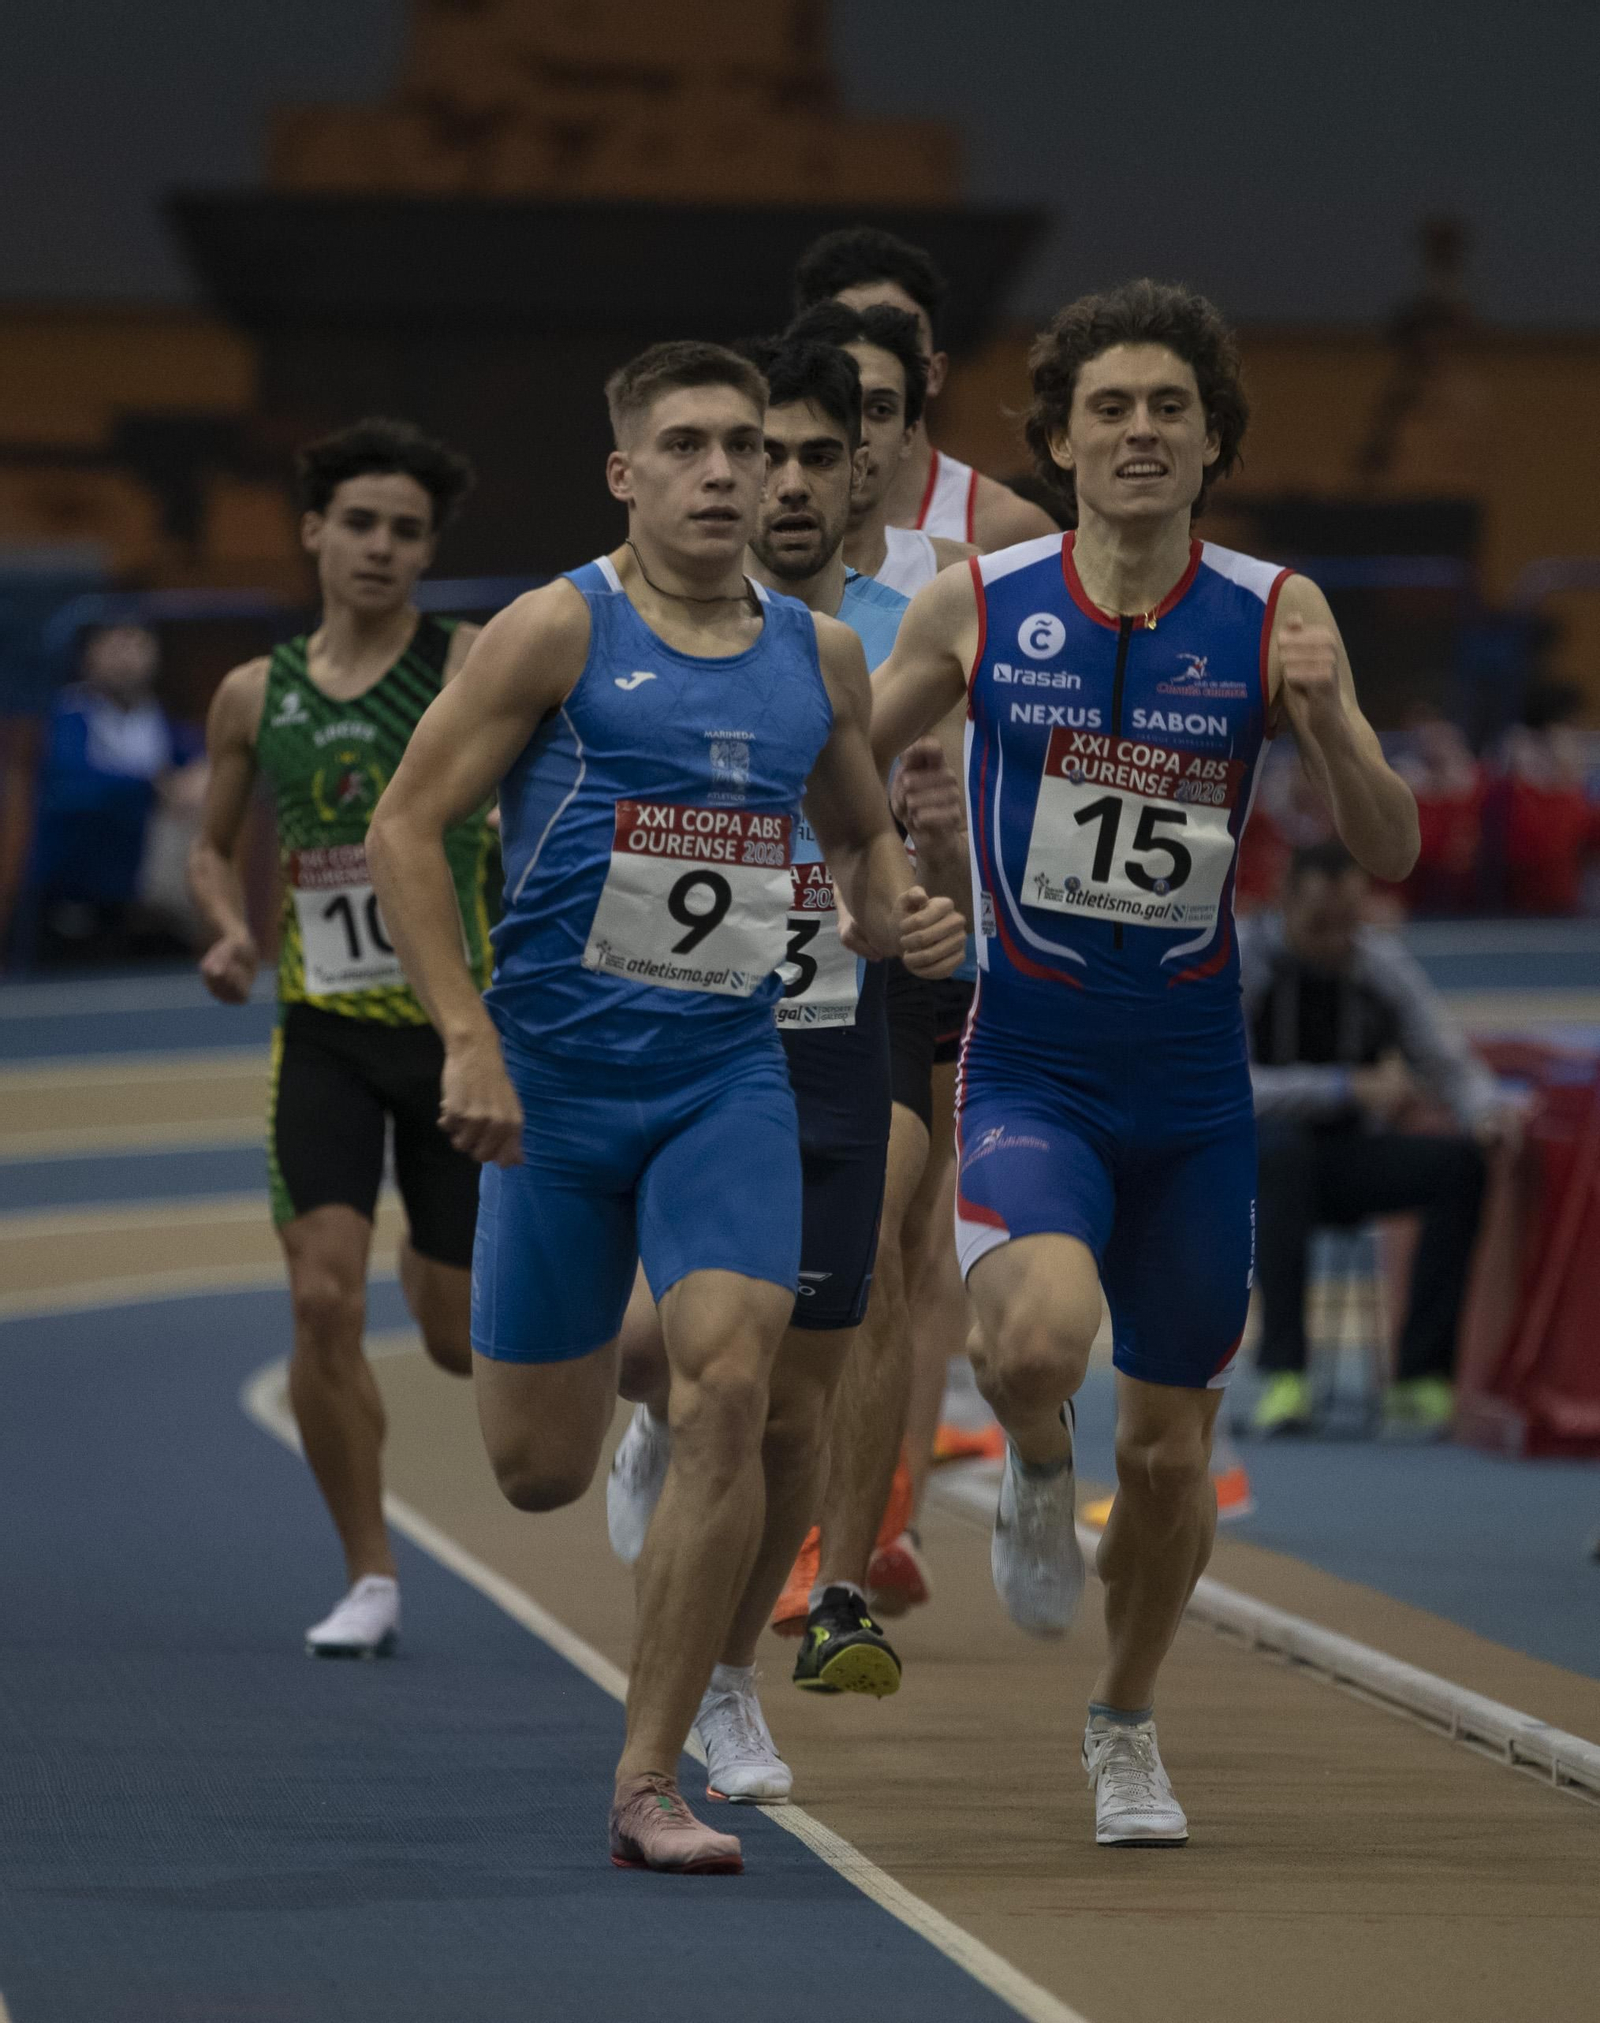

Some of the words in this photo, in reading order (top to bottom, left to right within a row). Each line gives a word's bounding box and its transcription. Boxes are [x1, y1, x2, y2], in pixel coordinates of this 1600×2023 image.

[1010, 702, 1102, 729] NEXUS
[1131, 707, 1228, 738] SABON
[704, 731, 756, 740] MARINEDA
[1069, 732, 1111, 759] XXI
[1117, 741, 1180, 775] COPA
[1185, 757, 1229, 780] ABS
[1060, 755, 1172, 797] OURENSE
[1173, 778, 1228, 804] 2026
[636, 804, 676, 828] XXI
[681, 809, 743, 837] COPA
[747, 816, 782, 840] ABS
[628, 829, 736, 861] OURENSE
[741, 840, 785, 866] 2026
[1073, 795, 1192, 893] 15
[668, 869, 732, 954] 9
[1065, 889, 1172, 921] atletismo.gal
[626, 957, 730, 987] atletismo.gal
